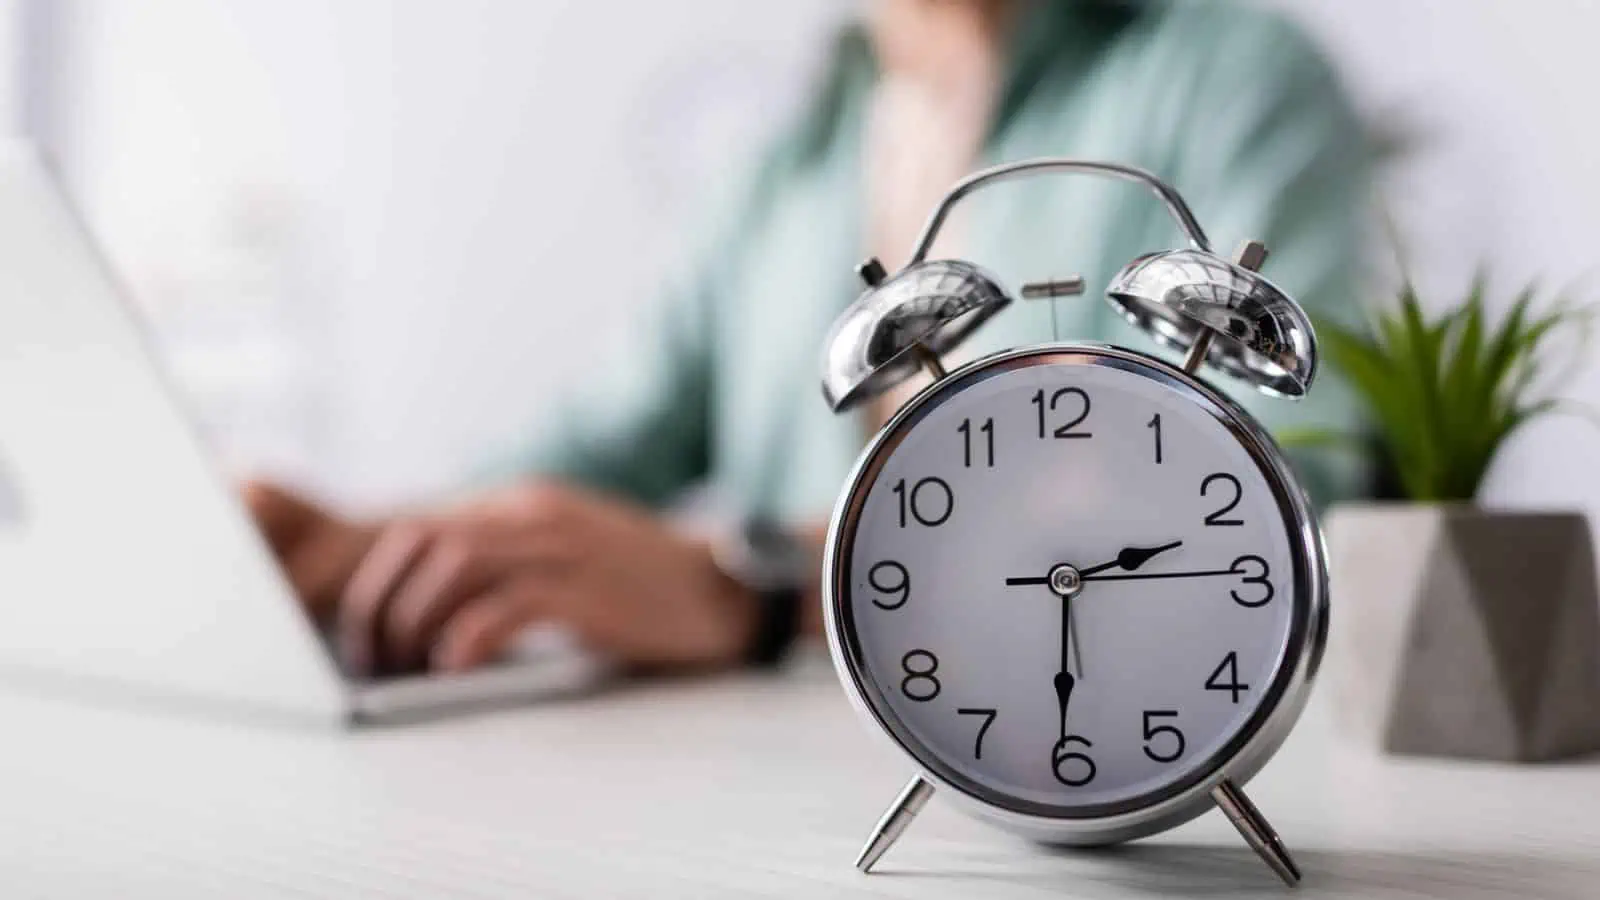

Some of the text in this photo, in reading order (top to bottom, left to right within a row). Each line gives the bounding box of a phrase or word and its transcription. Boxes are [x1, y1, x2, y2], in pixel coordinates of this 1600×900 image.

[1031, 386, 1092, 439] 12
[1147, 413, 1163, 465] 1
[957, 417, 995, 468] 11
[891, 475, 955, 529] 10
[1199, 472, 1245, 527] 2
[867, 560, 911, 612] 9
[1229, 554, 1275, 609] 3
[901, 648, 941, 702] 8
[1204, 650, 1250, 705] 4
[957, 707, 997, 760] 7
[1142, 709, 1186, 764] 5
[1051, 734, 1097, 788] 6
